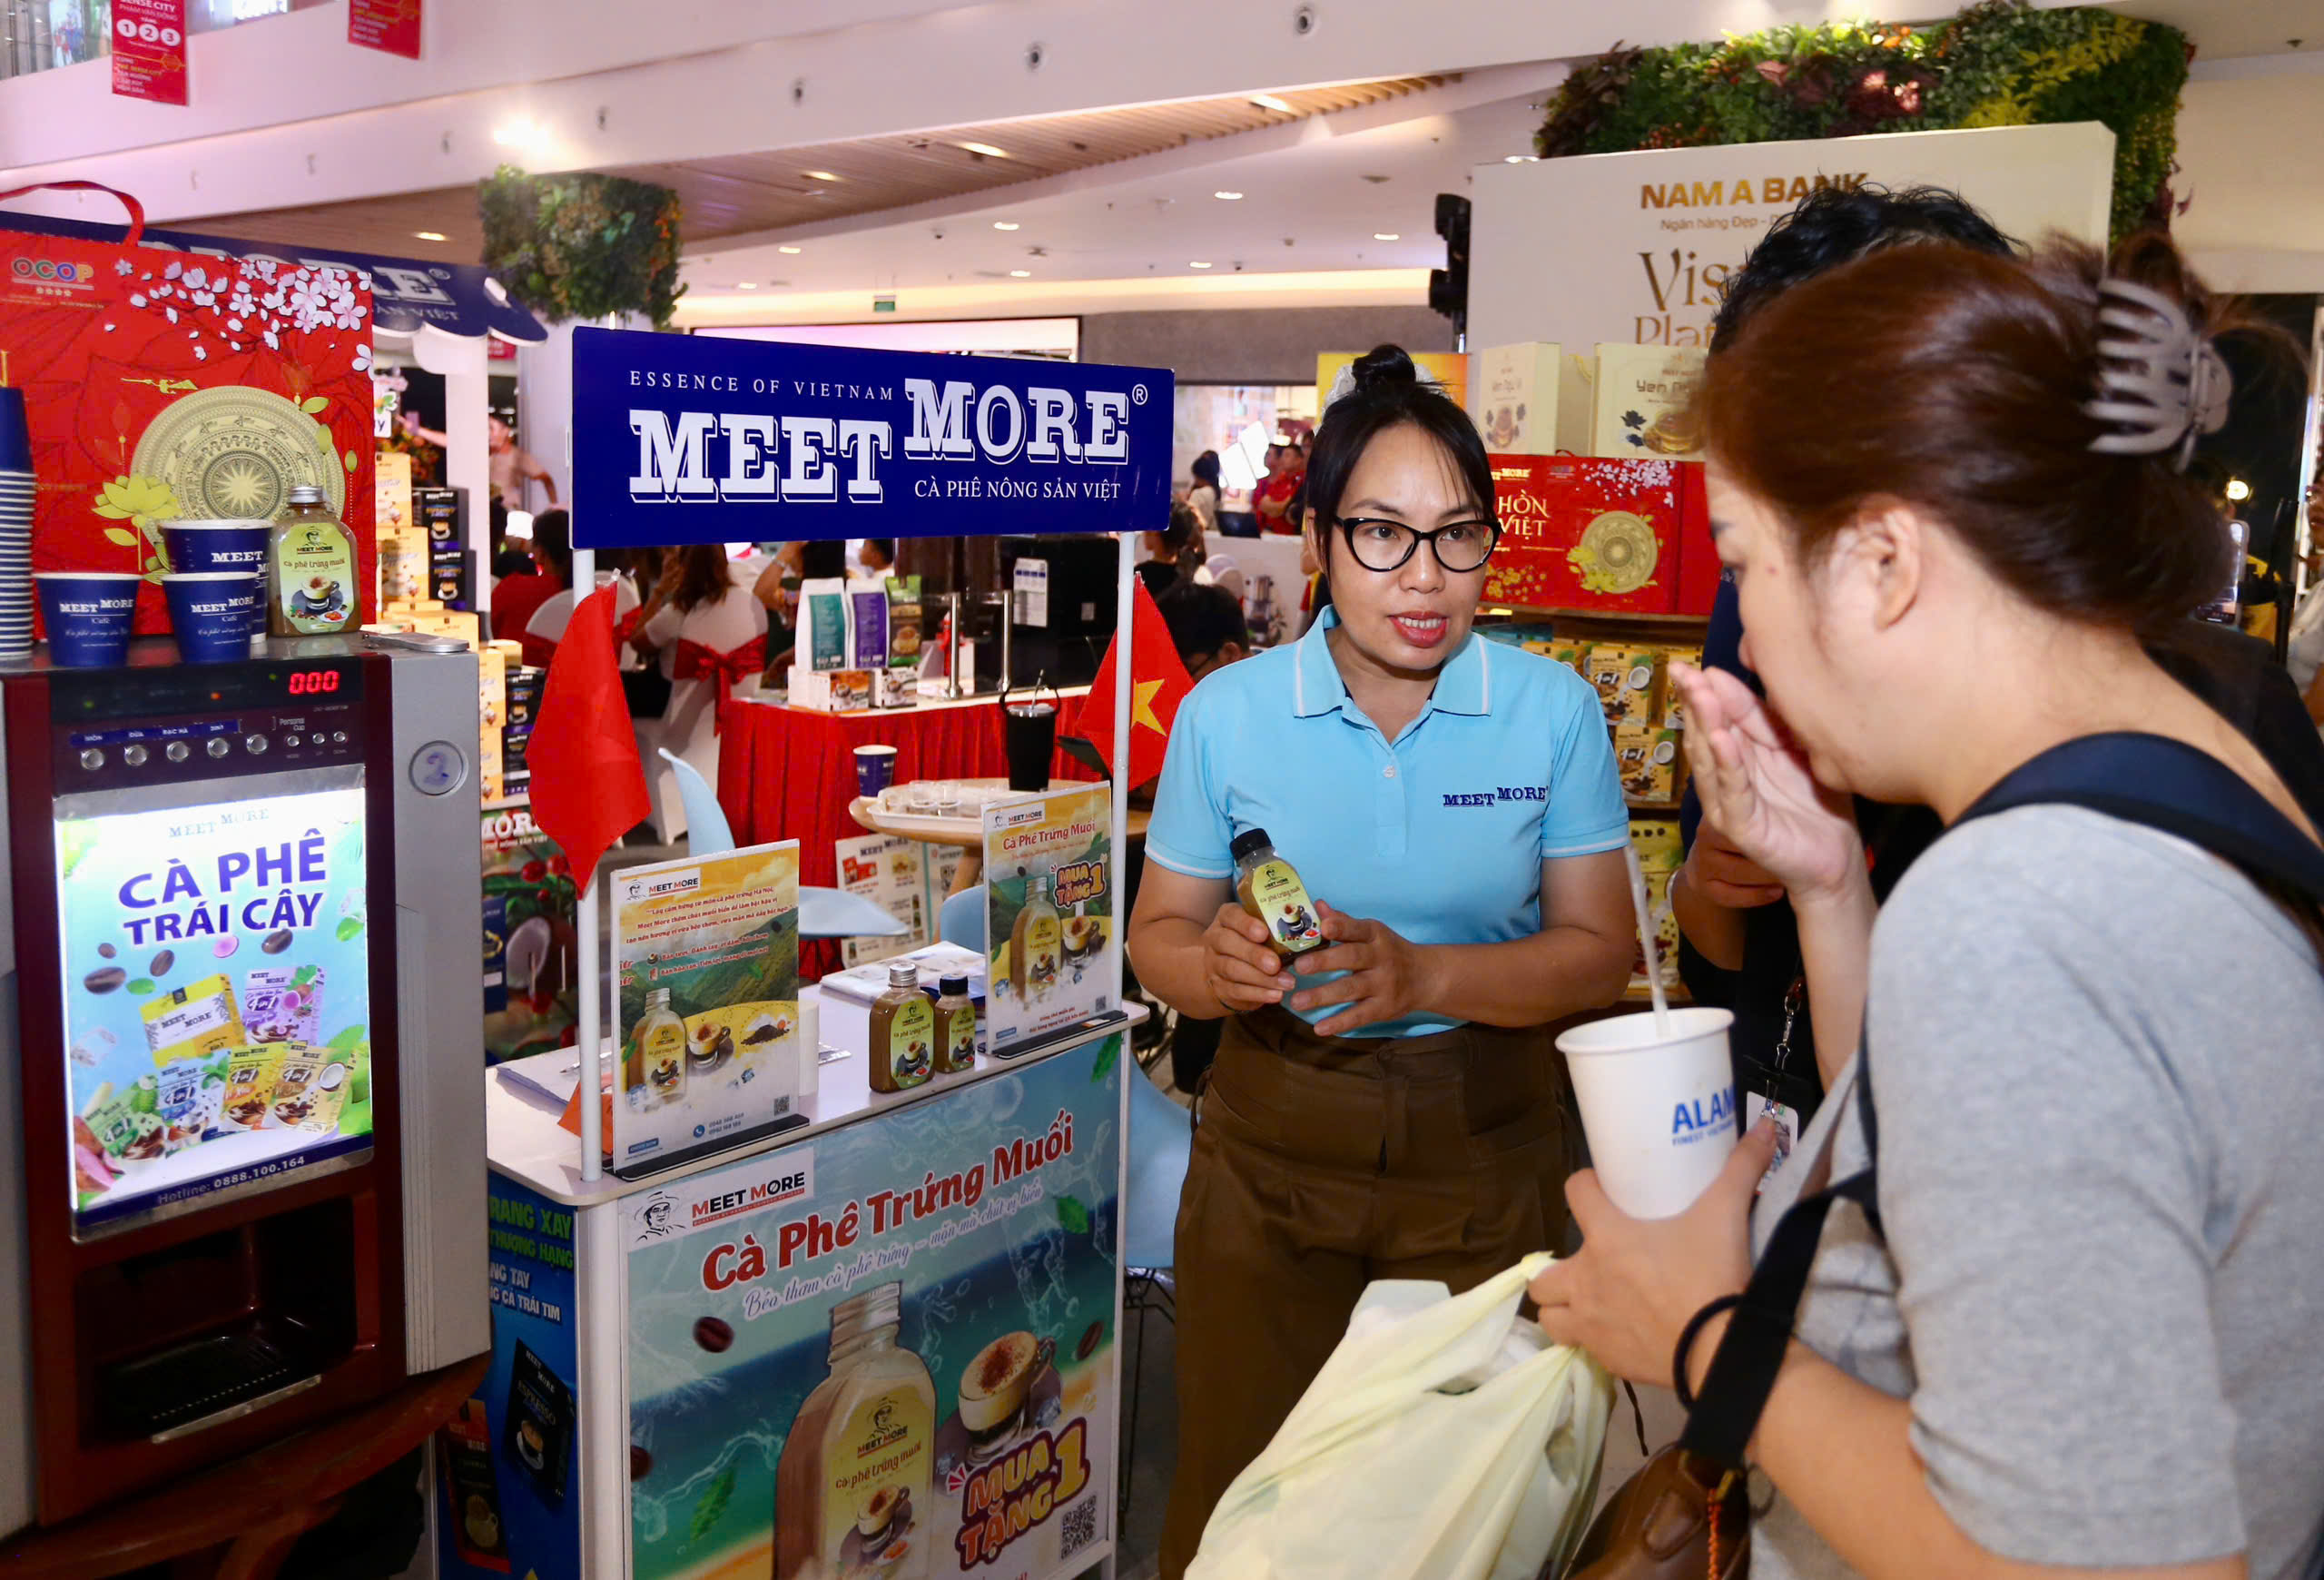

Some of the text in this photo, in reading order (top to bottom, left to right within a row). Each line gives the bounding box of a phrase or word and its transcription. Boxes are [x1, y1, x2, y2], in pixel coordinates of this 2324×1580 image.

[1640, 181, 1723, 209] NAM
[1728, 180, 1755, 205] A
[1660, 218, 1694, 232] Ngân
[12, 258, 94, 283] OCOP
[629, 370, 894, 401] ESSENCE OF VIETNAM
[628, 409, 892, 504] MEET
[913, 477, 1122, 502] CÀ PHÊ NÔNG SẢN VIỆT
[211, 550, 263, 564] MEET
[59, 603, 99, 614] MEET
[192, 603, 228, 614] MEET
[1443, 793, 1496, 807] MEET
[169, 822, 218, 838] MEET
[1009, 810, 1043, 822] MEET MORE
[1003, 836, 1017, 851] Cà
[1019, 832, 1037, 847] Phê
[1039, 827, 1068, 843] Trứng
[1071, 817, 1097, 836] Muối
[118, 827, 327, 910] CÀ PHÊ
[1058, 864, 1089, 886] MUA
[1089, 862, 1105, 895] 1
[648, 877, 699, 894] MEET MORE
[1057, 881, 1090, 906] TẶNG
[123, 888, 324, 945] TRÁI CÂY
[637, 922, 653, 930] Meet
[654, 919, 670, 927] More
[156, 1155, 306, 1205] Hotline: 0888.100.164
[692, 1171, 805, 1219] MEET MORE
[702, 1108, 1074, 1291] Cà Phê Trứng Muối
[488, 1195, 572, 1240] RANG XAY
[539, 1242, 574, 1270] HẠNG
[743, 1179, 1044, 1318] Béo thơm cà phê trứng mặn mà chút vị biển
[509, 1267, 530, 1289] TAY
[501, 1288, 516, 1307] CẢ
[517, 1294, 540, 1315] TRÁI
[541, 1302, 561, 1322] TIM
[857, 1424, 909, 1455] MEET MORE
[967, 1437, 1051, 1515] MUA
[1052, 1424, 1087, 1500] 1
[851, 1466, 872, 1490] phê
[960, 1476, 1056, 1565] TẶNG
